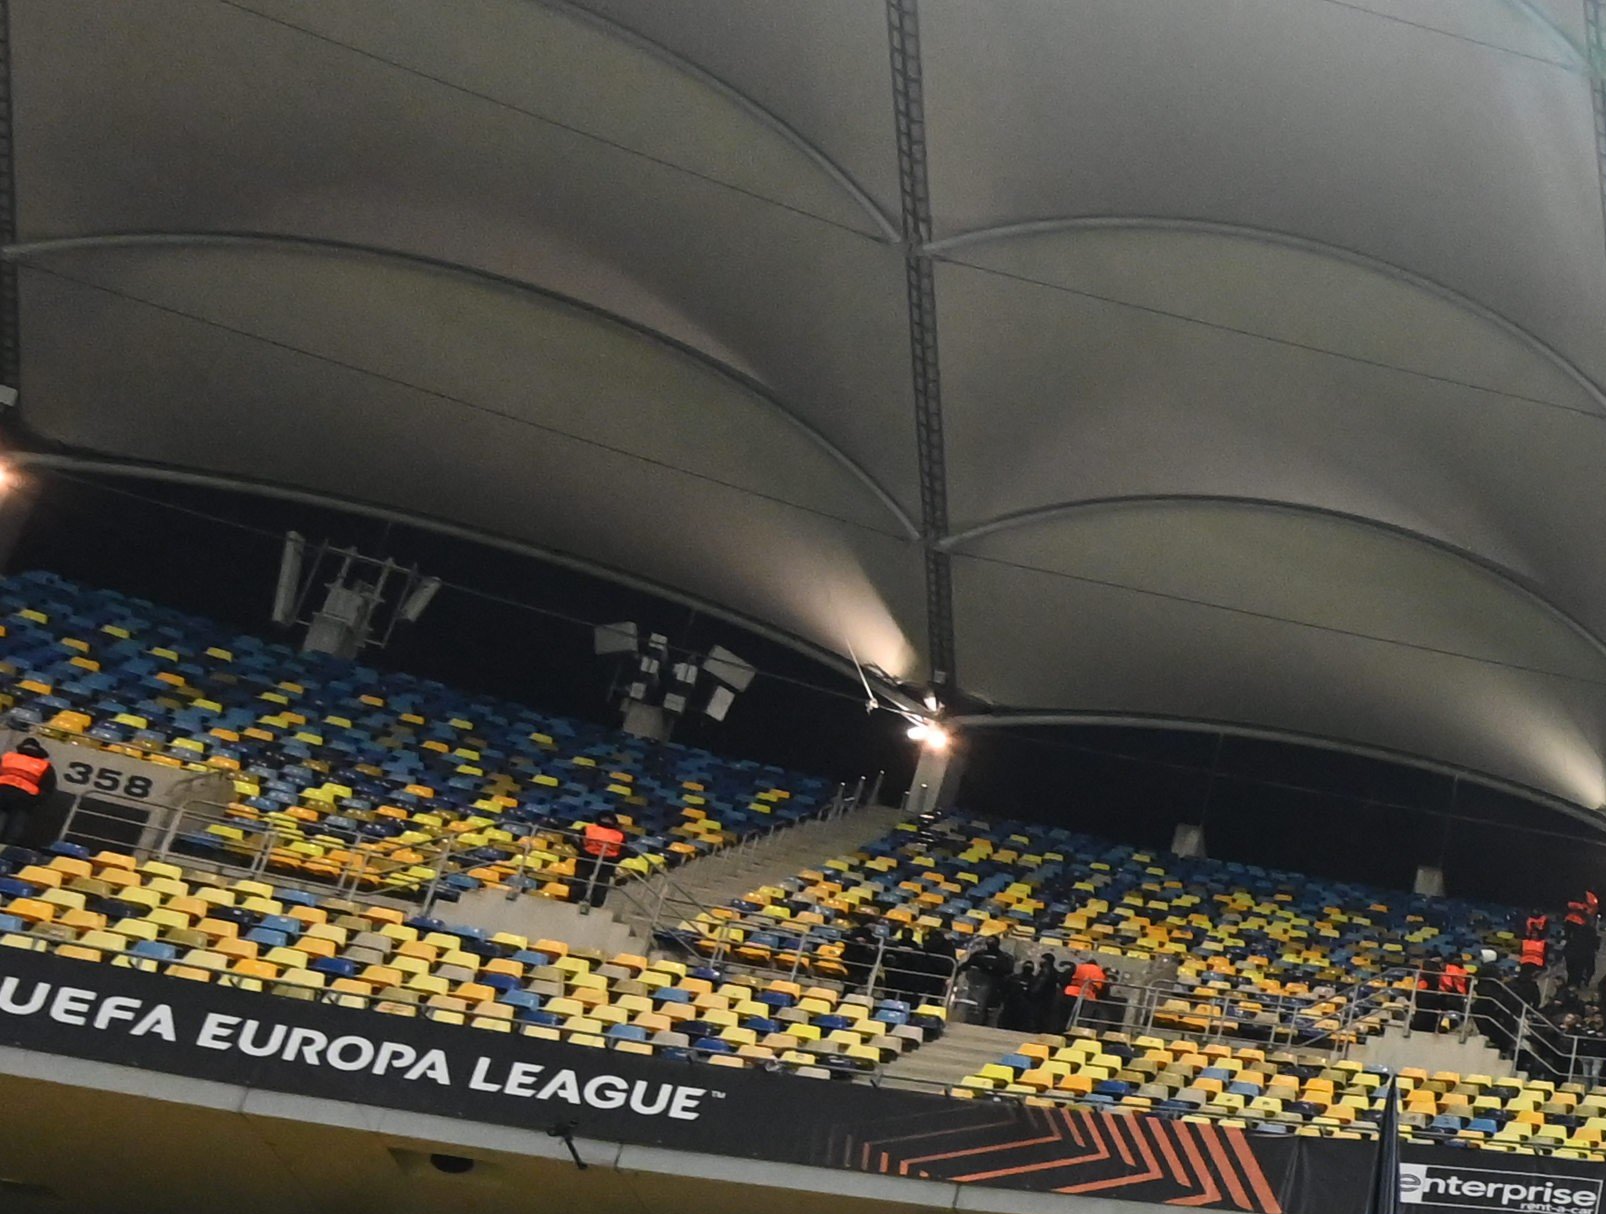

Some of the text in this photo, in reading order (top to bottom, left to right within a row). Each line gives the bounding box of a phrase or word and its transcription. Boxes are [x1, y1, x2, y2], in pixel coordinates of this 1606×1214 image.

[63, 762, 153, 798] 358
[0, 975, 176, 1041] UEFA
[196, 1012, 450, 1085] EUROPA
[468, 1055, 705, 1121] LEAGUE
[1399, 1174, 1598, 1207] enterprise
